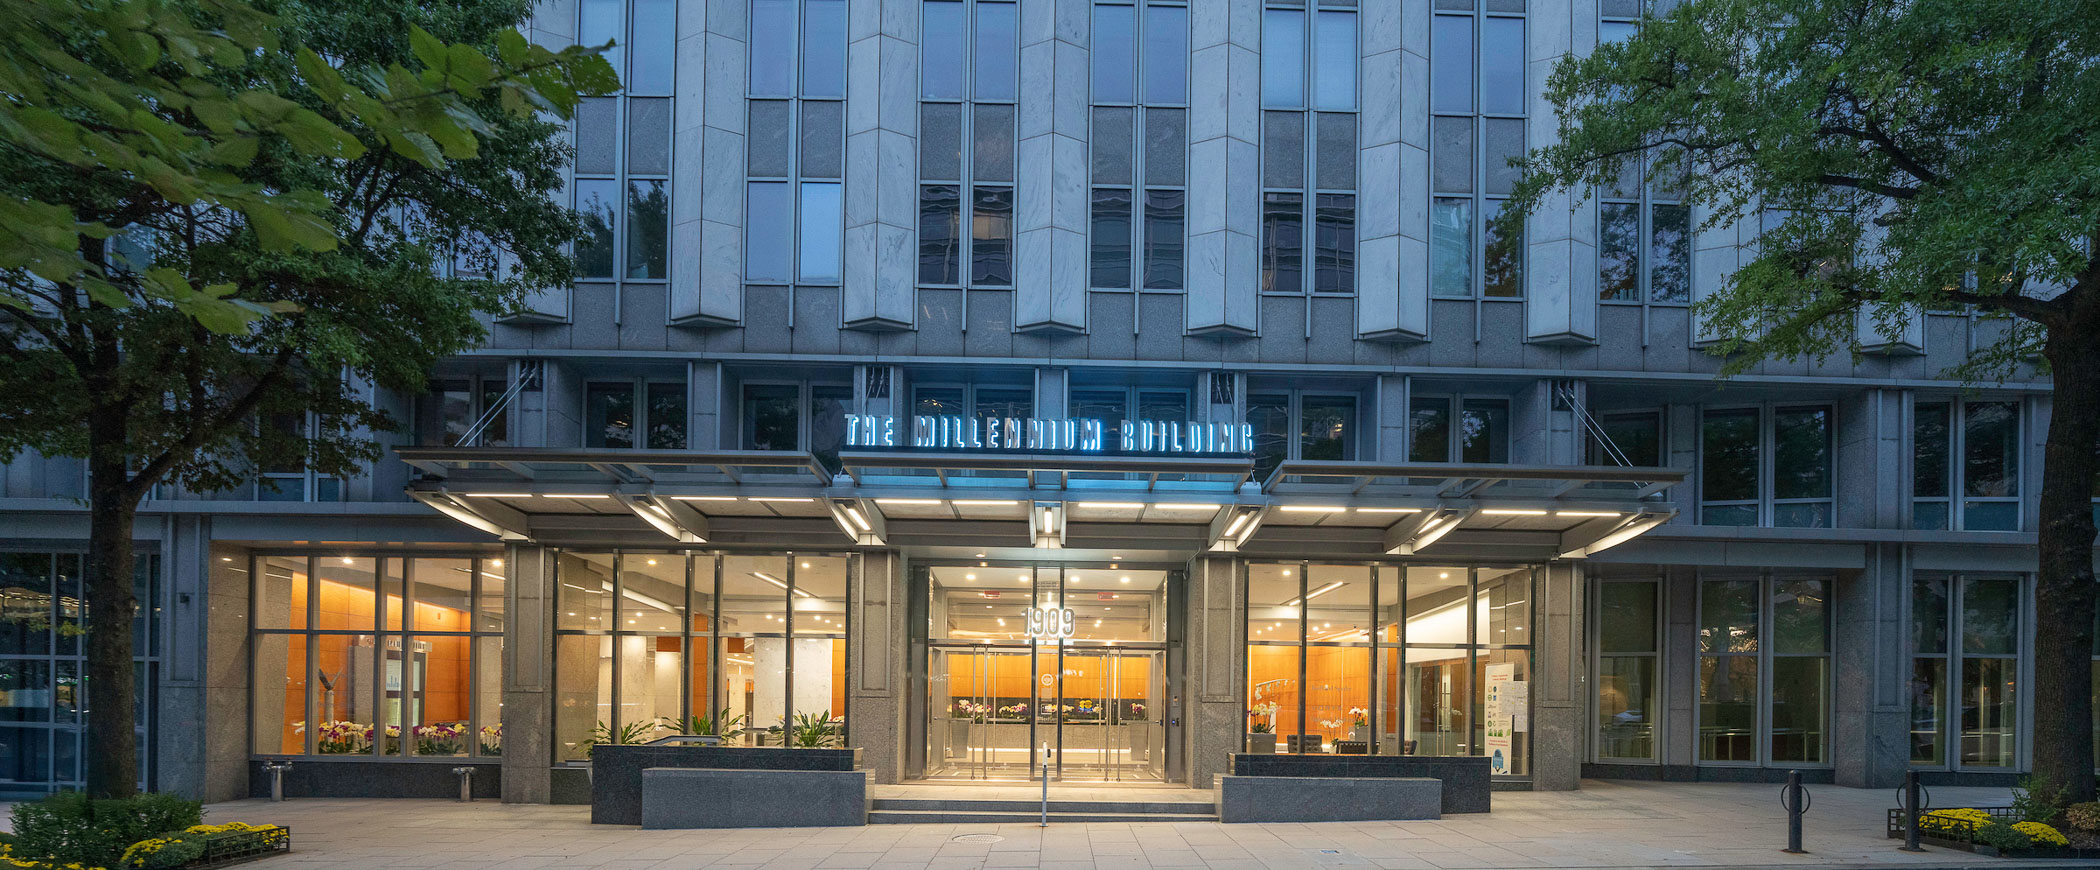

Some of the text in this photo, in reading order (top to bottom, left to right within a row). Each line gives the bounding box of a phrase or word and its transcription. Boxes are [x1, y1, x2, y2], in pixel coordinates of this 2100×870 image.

[844, 413, 1254, 453] THE MILLENNIUM BUILDING
[1021, 607, 1076, 637] 1909
